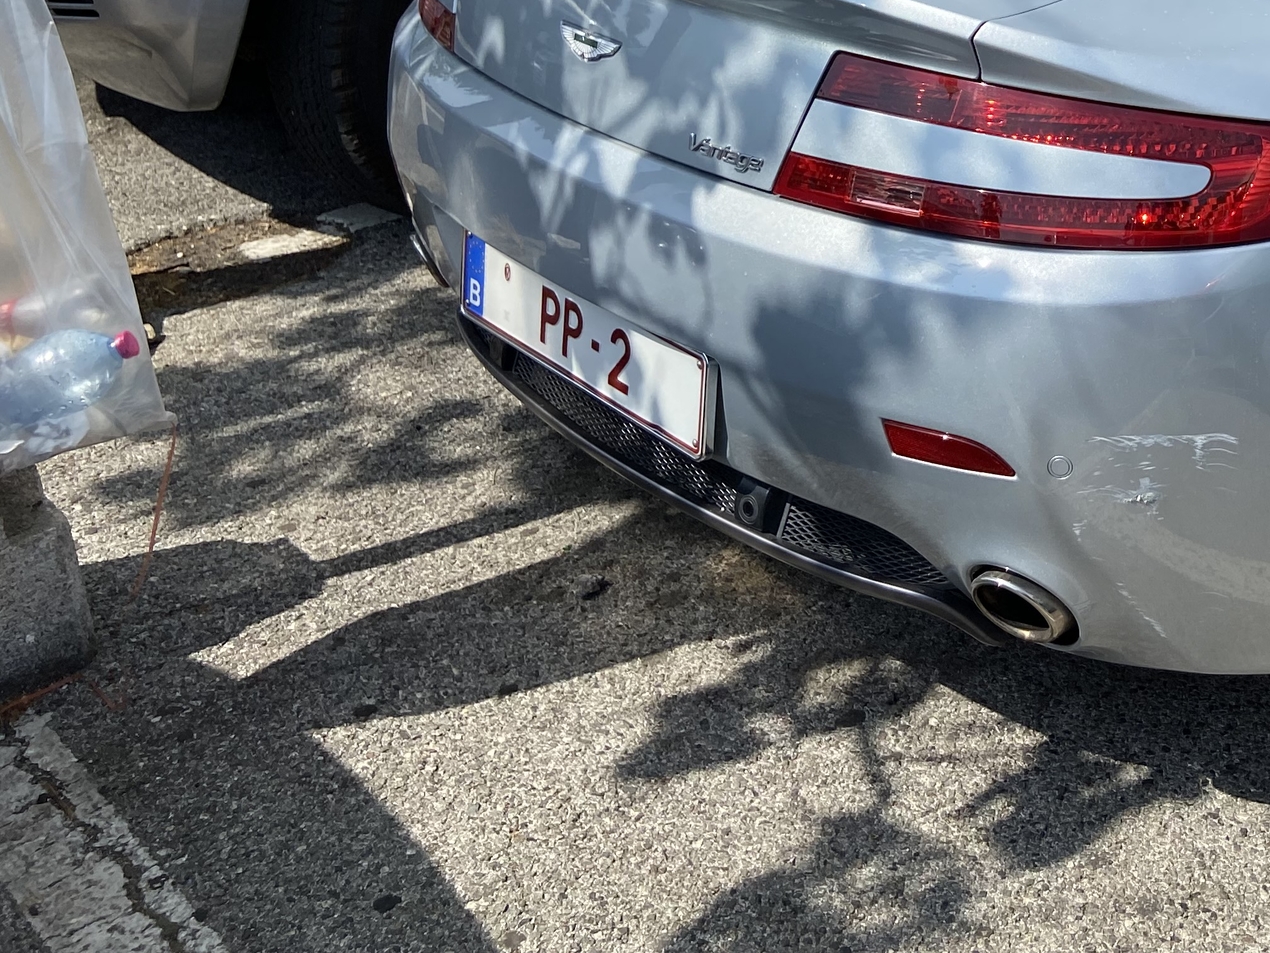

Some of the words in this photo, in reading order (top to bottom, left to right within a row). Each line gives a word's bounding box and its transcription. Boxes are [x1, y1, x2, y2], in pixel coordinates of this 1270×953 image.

[688, 132, 764, 173] Vantage
[470, 278, 481, 306] B
[540, 284, 631, 396] PP-2
